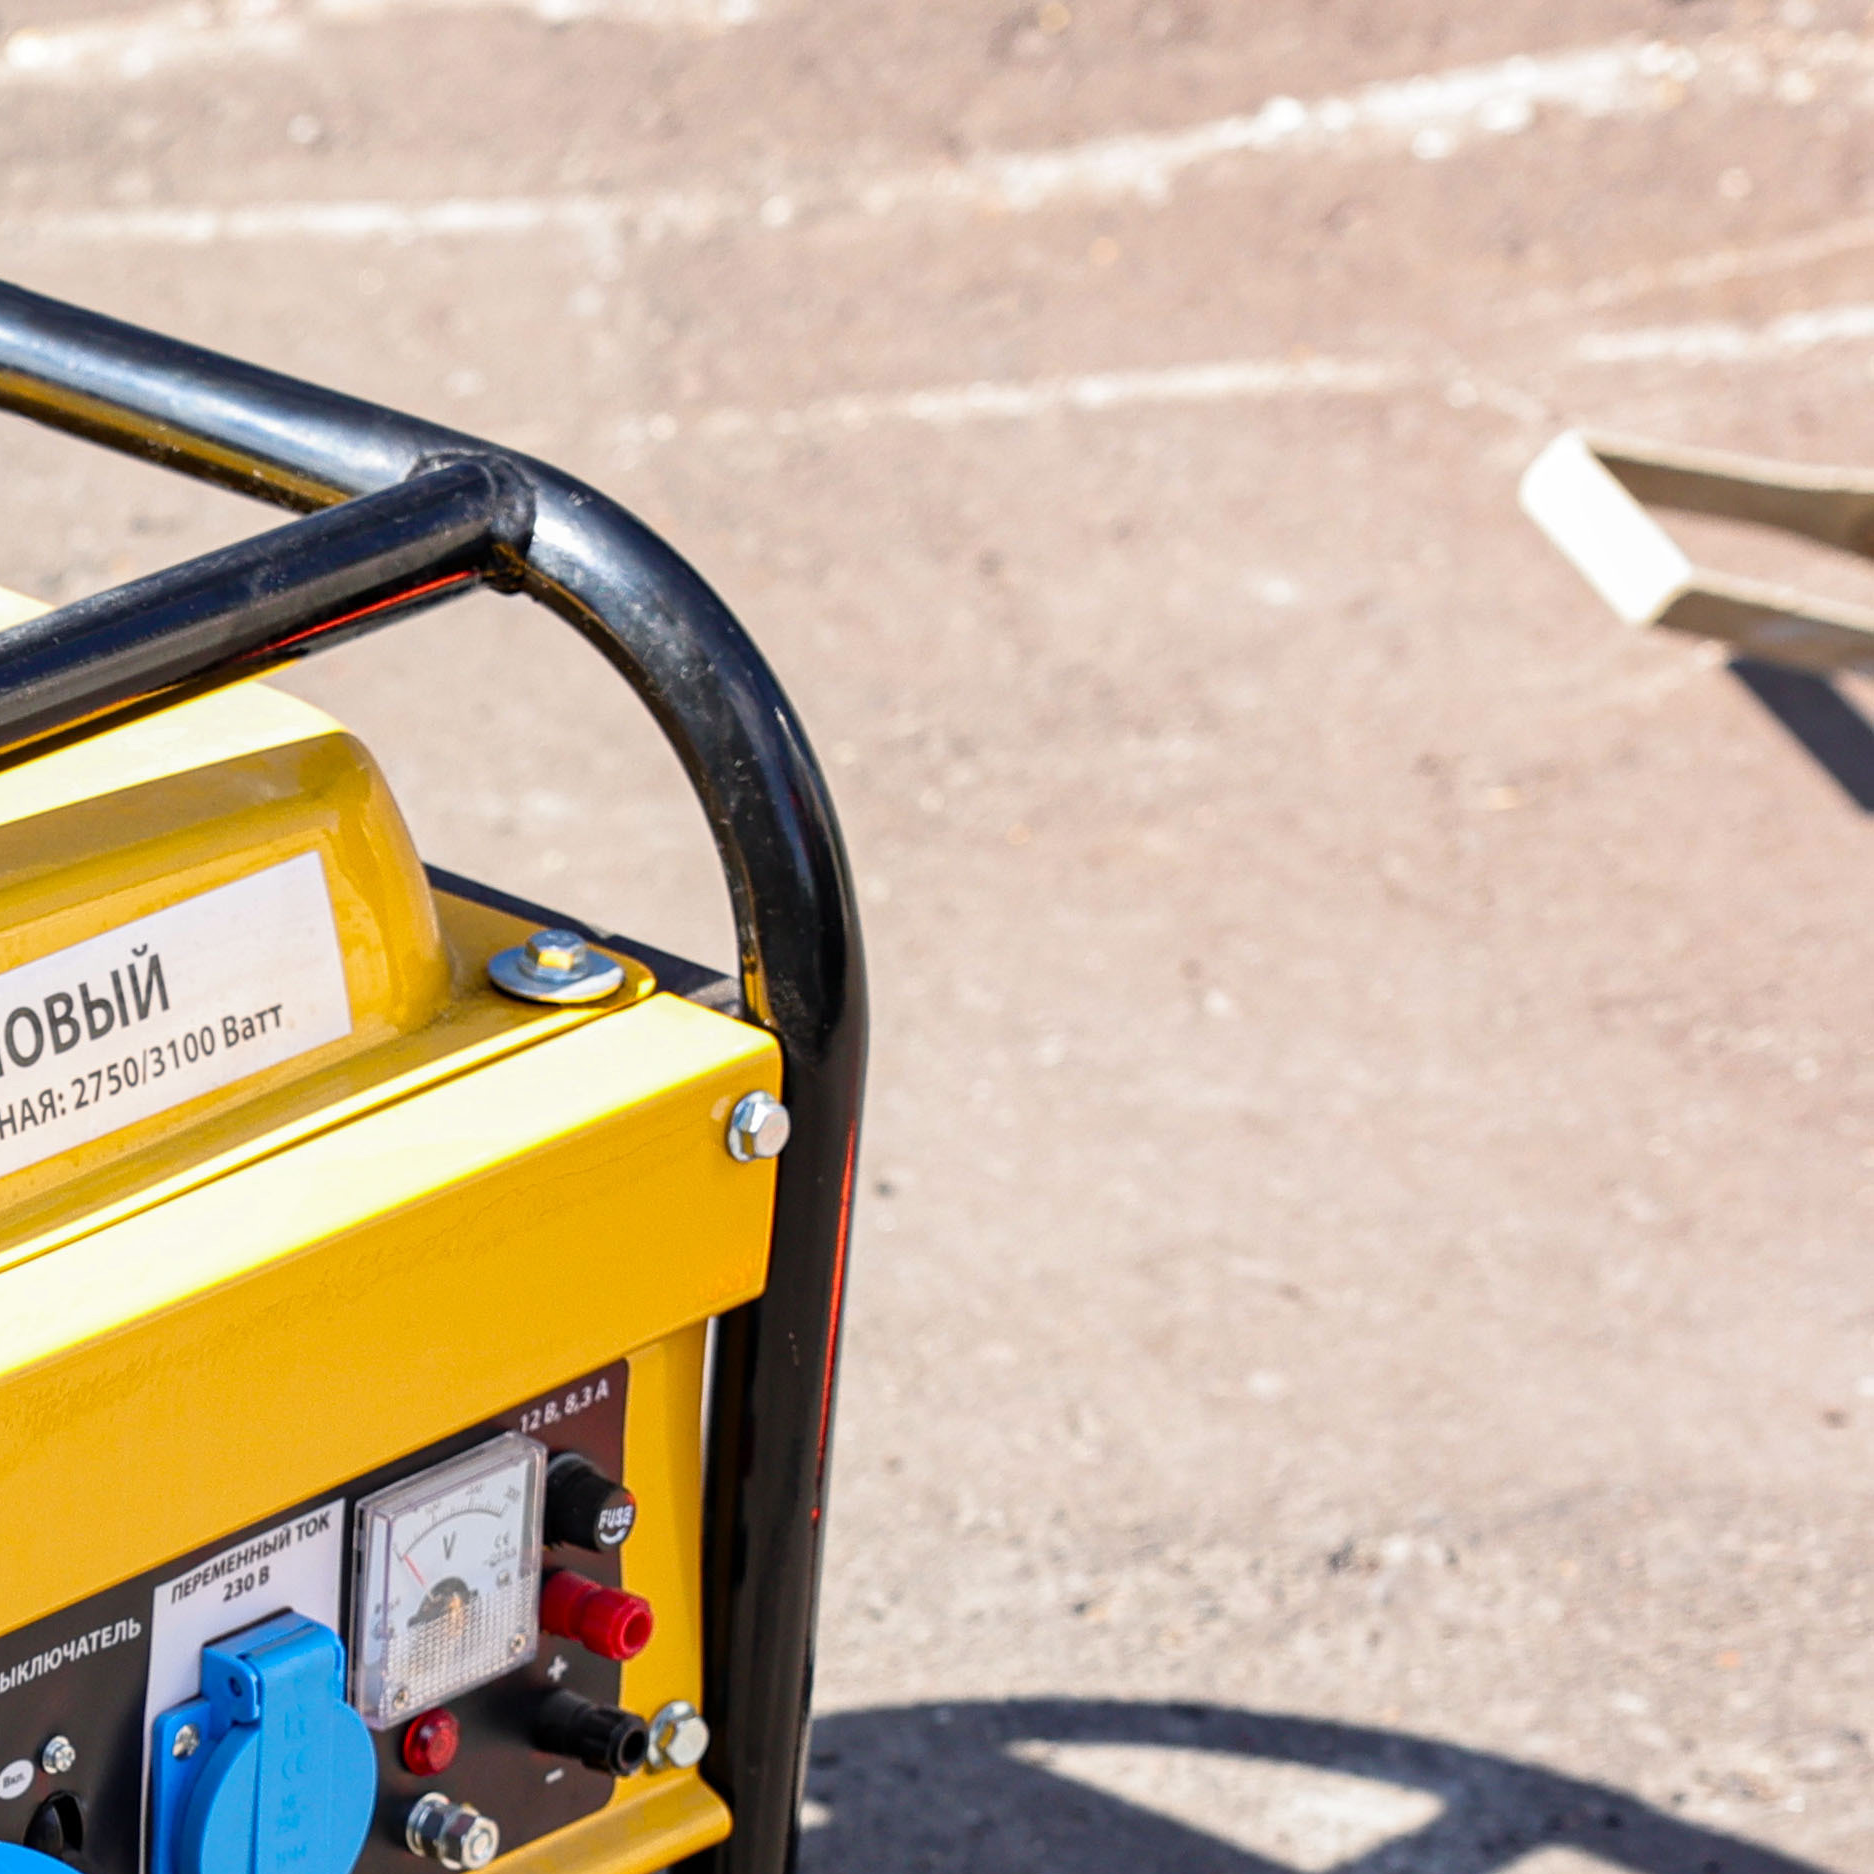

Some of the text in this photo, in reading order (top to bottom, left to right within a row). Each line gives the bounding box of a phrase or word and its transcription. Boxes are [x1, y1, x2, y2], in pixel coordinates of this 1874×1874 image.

[73, 1026, 215, 1110] 2750/3100
[221, 1004, 283, 1049] Ватт
[520, 1409, 540, 1433] 12
[598, 1504, 633, 1530] FUSE
[171, 1512, 331, 1605] ПЕРЕМЕННЫЙ ТОК
[222, 1567, 270, 1603] 230 В
